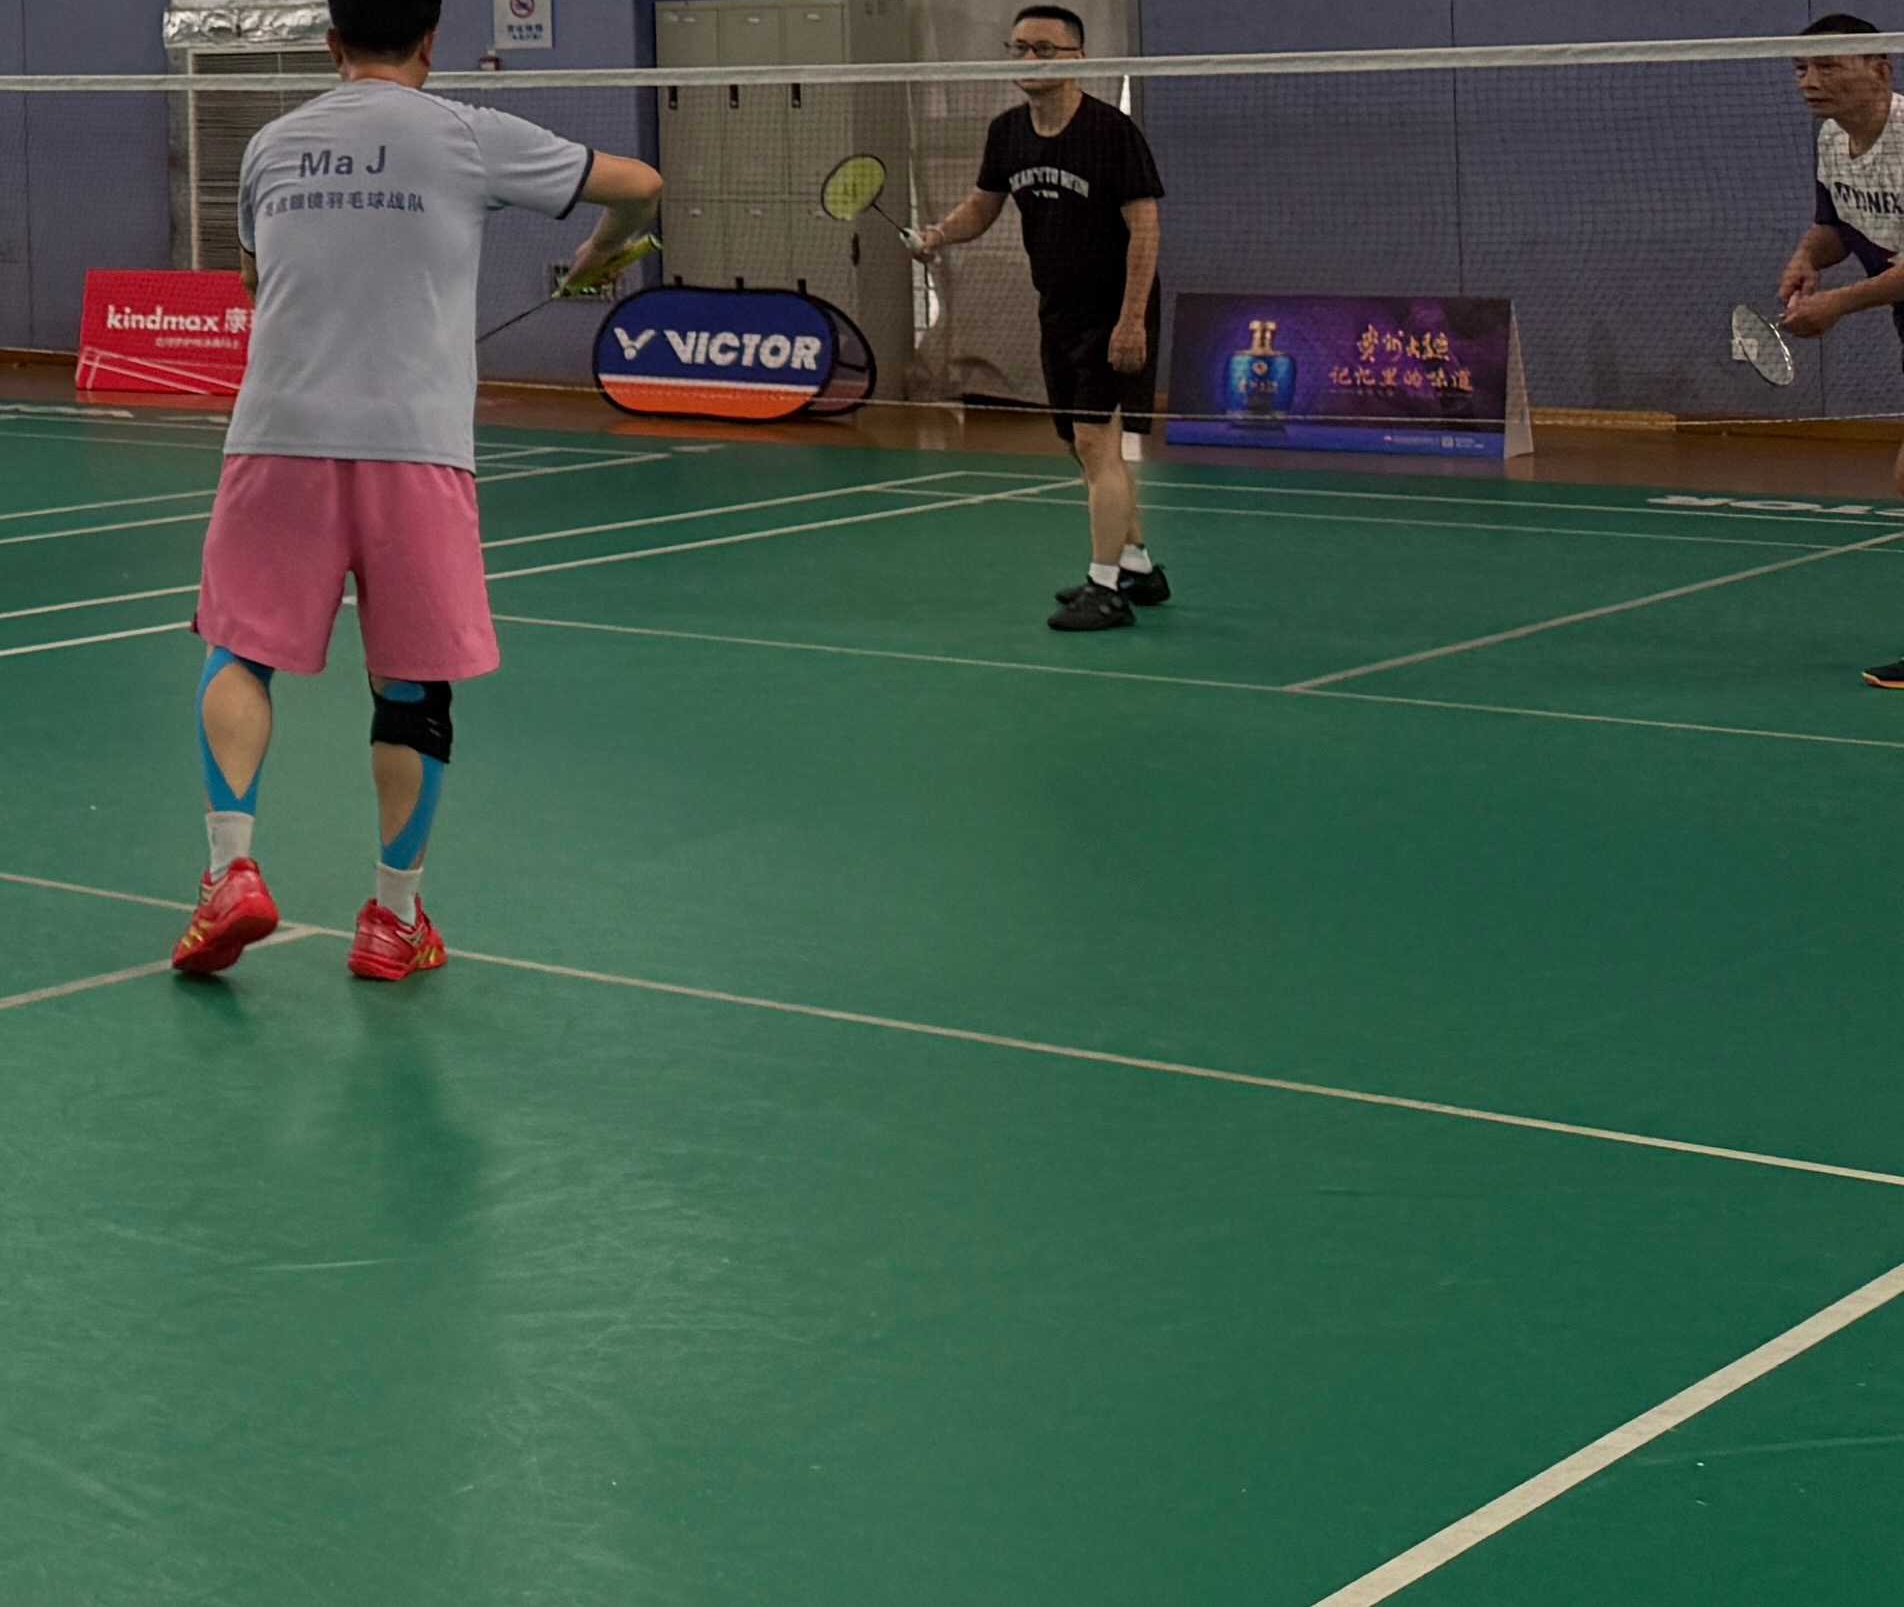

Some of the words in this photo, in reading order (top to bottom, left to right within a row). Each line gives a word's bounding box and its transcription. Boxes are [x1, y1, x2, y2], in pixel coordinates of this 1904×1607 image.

[299, 149, 355, 178] Ma
[365, 145, 386, 175] J
[106, 304, 220, 332] kindmax
[664, 330, 822, 370] VICTOR
